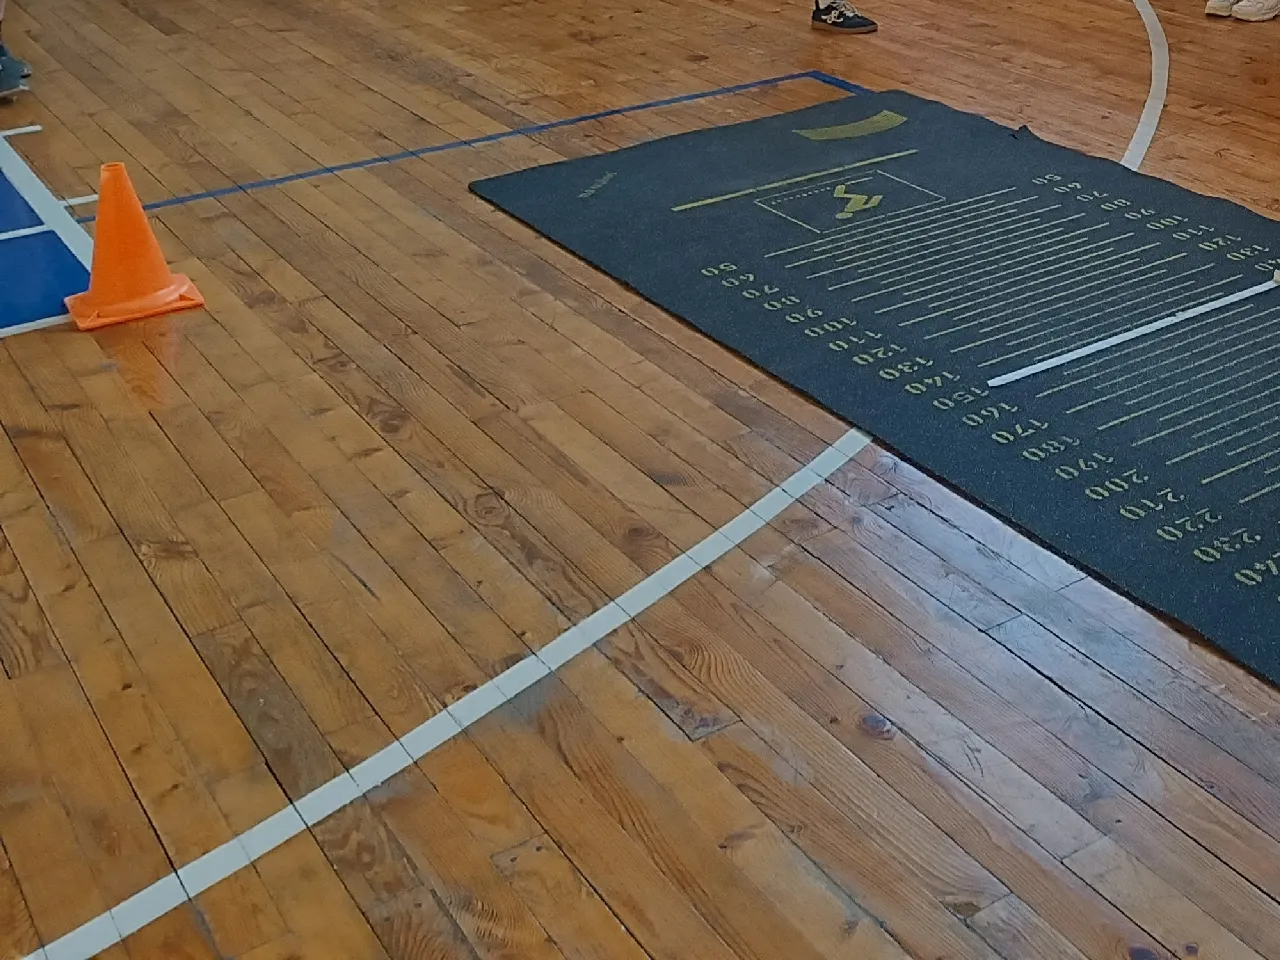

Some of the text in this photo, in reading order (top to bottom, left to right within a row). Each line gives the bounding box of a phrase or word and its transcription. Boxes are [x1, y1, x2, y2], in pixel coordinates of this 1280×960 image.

[1031, 173, 1062, 185] 50
[1053, 181, 1082, 193] 60
[1076, 190, 1110, 202] 70
[1100, 198, 1132, 211] 80
[1124, 207, 1156, 220] 90
[1146, 214, 1189, 231] 100
[1172, 224, 1215, 241] 110
[1198, 234, 1242, 251] 120
[1226, 244, 1270, 262] 130
[701, 262, 738, 277] 50
[721, 272, 755, 287] 60
[741, 284, 780, 299] 70
[762, 295, 801, 311] 80
[785, 308, 824, 323] 90
[804, 316, 857, 337] 100
[828, 330, 883, 351] 110
[853, 343, 908, 365] 120
[878, 356, 934, 380] 130
[904, 370, 961, 395] 140
[932, 386, 990, 411] 150
[961, 402, 1019, 426] 160
[991, 418, 1049, 444] 170
[1021, 435, 1080, 461] 180
[1055, 452, 1114, 479] 190
[1084, 468, 1149, 500] 200
[1119, 487, 1185, 520] 210
[1156, 507, 1223, 541] 220
[1193, 527, 1262, 562] 230
